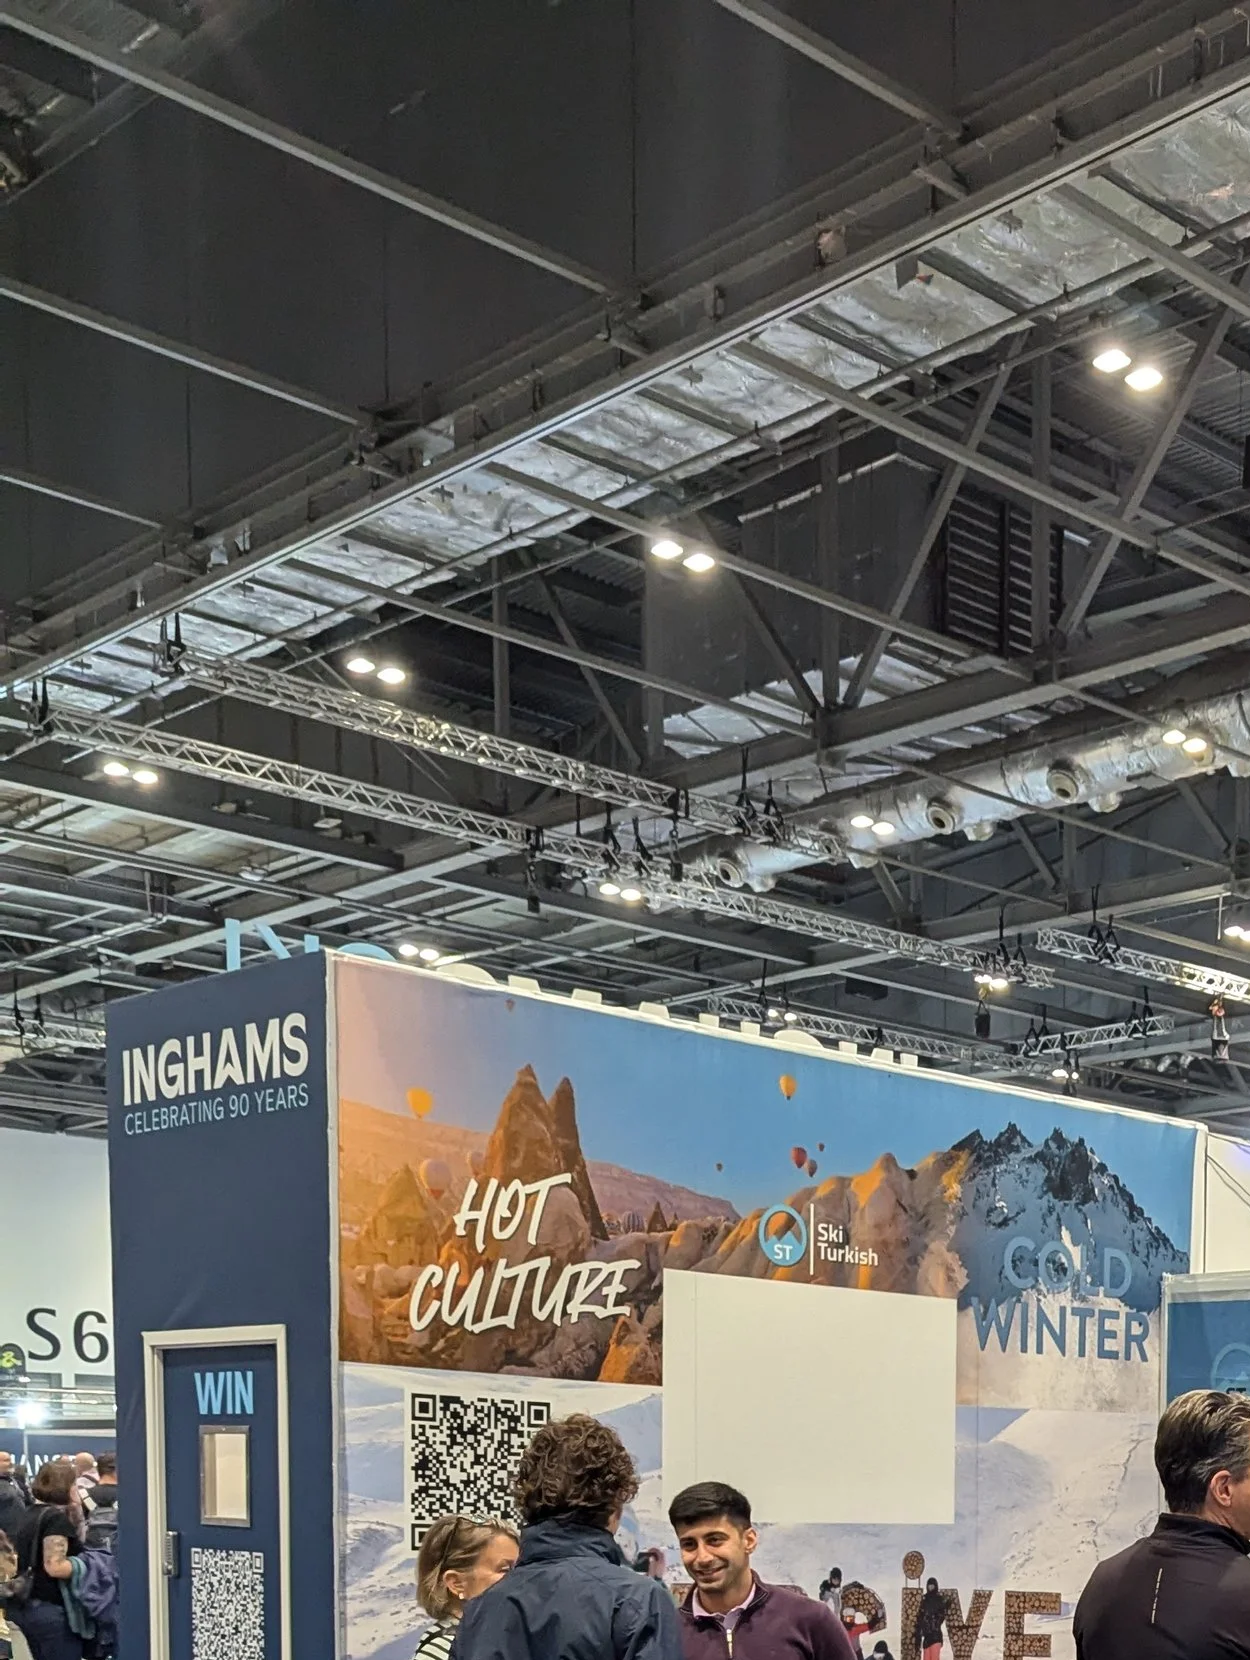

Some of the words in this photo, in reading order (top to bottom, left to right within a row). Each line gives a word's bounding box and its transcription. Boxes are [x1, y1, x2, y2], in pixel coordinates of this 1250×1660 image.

[122, 1012, 309, 1106] INGHAMS
[124, 1097, 225, 1136] CELEBRATING
[228, 1093, 250, 1118] 90
[254, 1082, 309, 1114] YEARS
[453, 1172, 572, 1254] HOT
[817, 1223, 843, 1243] Ski
[773, 1244, 793, 1260] ST
[816, 1242, 879, 1267] Turkish
[1004, 1236, 1133, 1299] COLD
[409, 1256, 642, 1334] CULTURE
[26, 1307, 110, 1364] S6
[970, 1296, 1150, 1363] WINTER
[194, 1371, 255, 1415] WIN
